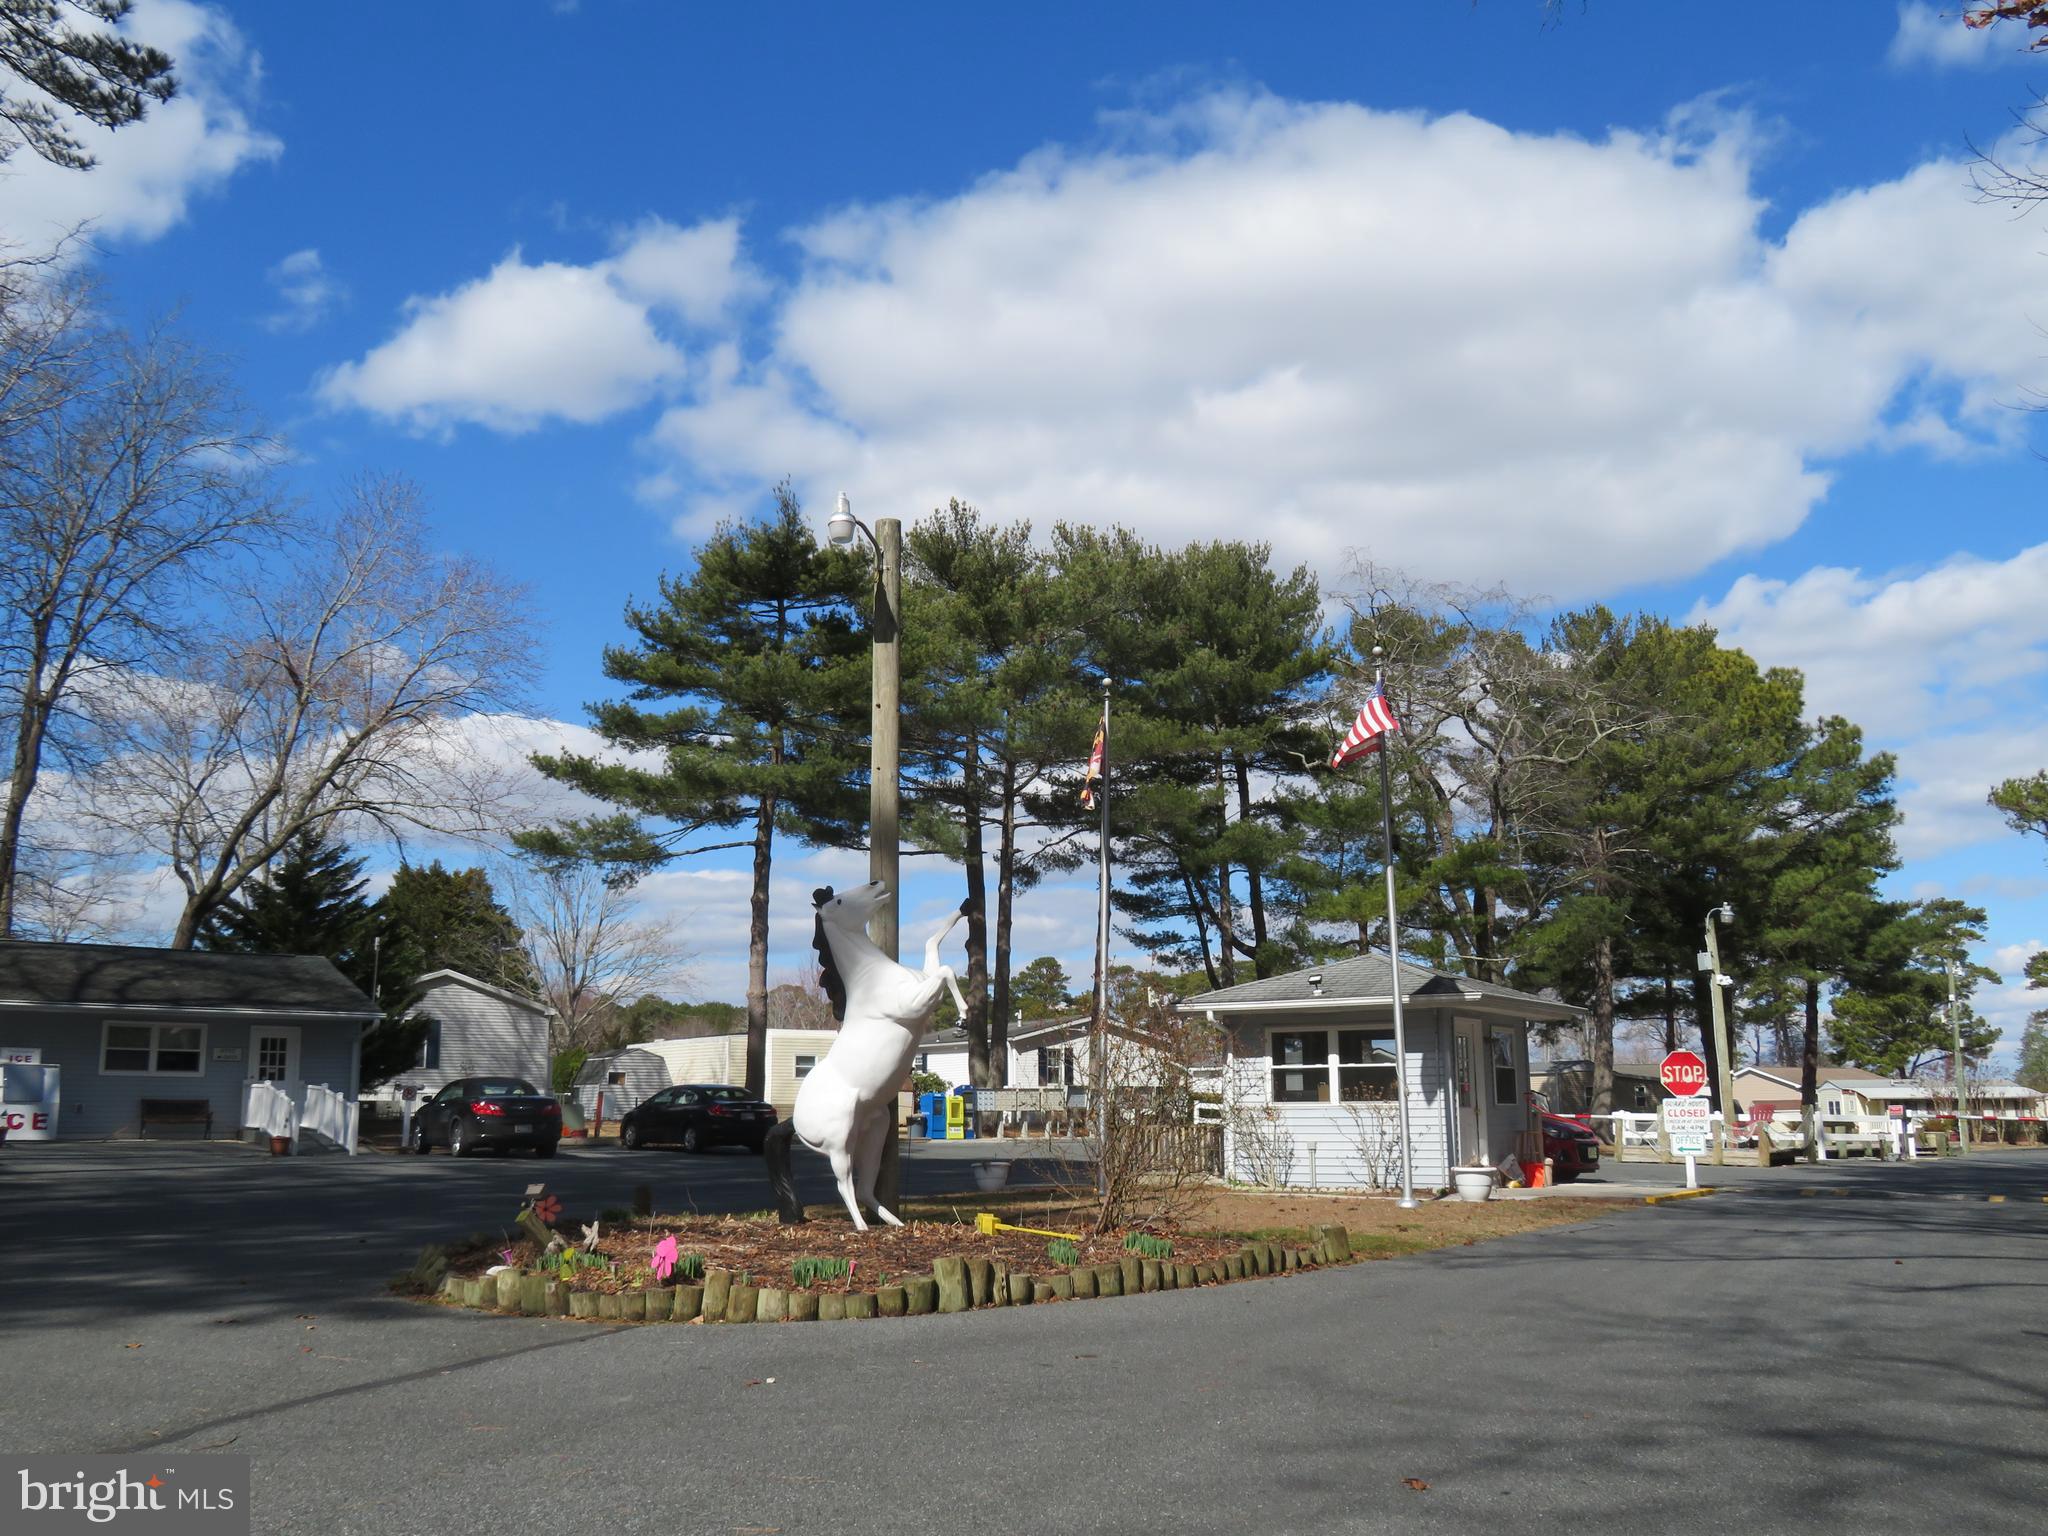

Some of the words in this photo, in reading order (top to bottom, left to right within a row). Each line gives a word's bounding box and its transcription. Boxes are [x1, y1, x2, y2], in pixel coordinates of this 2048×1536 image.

[9, 1055, 33, 1063] ICE
[1663, 1065, 1703, 1083] STOP
[1667, 1109, 1706, 1118] CLOSED
[6, 1112, 49, 1130] CE
[1675, 1136, 1701, 1144] OFFICE
